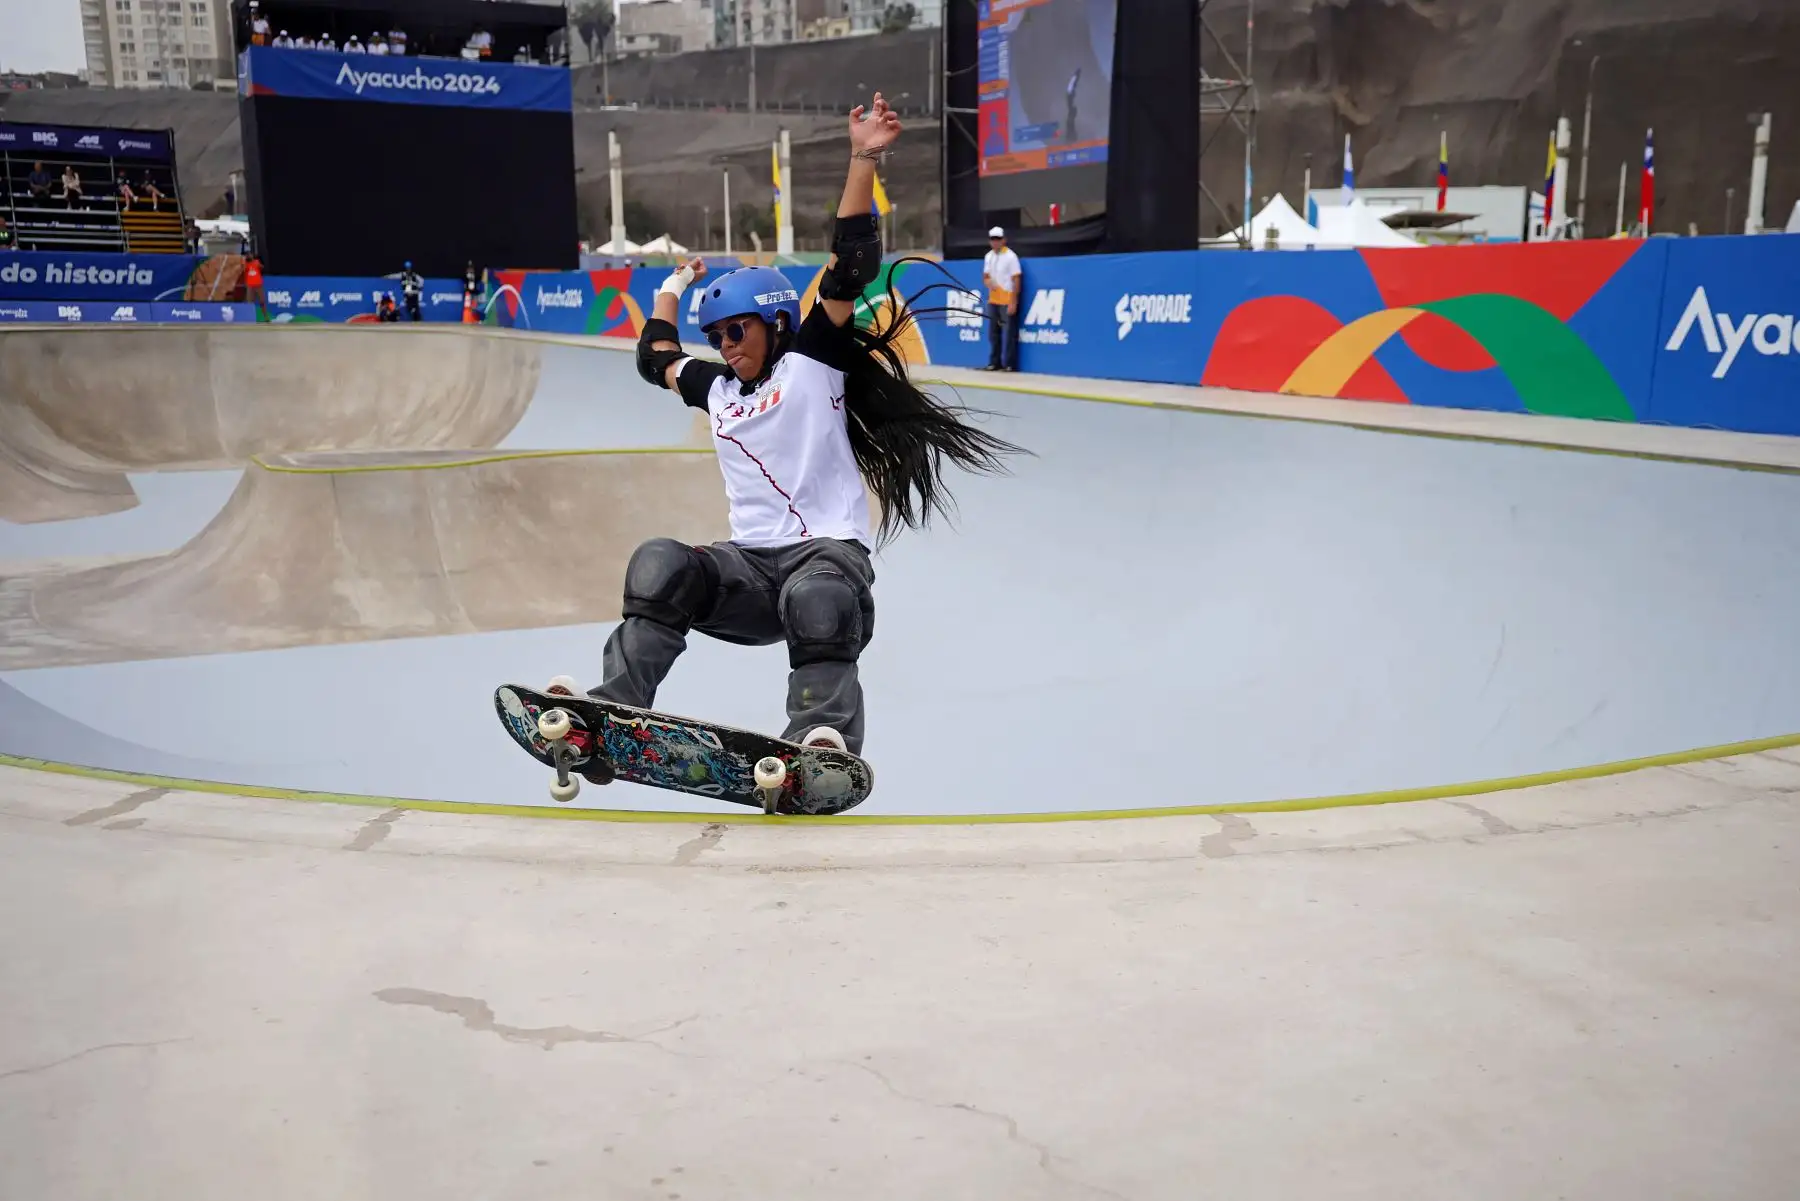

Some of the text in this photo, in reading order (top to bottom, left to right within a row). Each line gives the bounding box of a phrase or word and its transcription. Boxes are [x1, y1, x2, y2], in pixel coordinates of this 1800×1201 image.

[336, 62, 501, 95] Ayacucho2024
[1, 262, 153, 285] do historia
[1130, 294, 1192, 323] SPORADE
[1664, 285, 1800, 379] Aya
